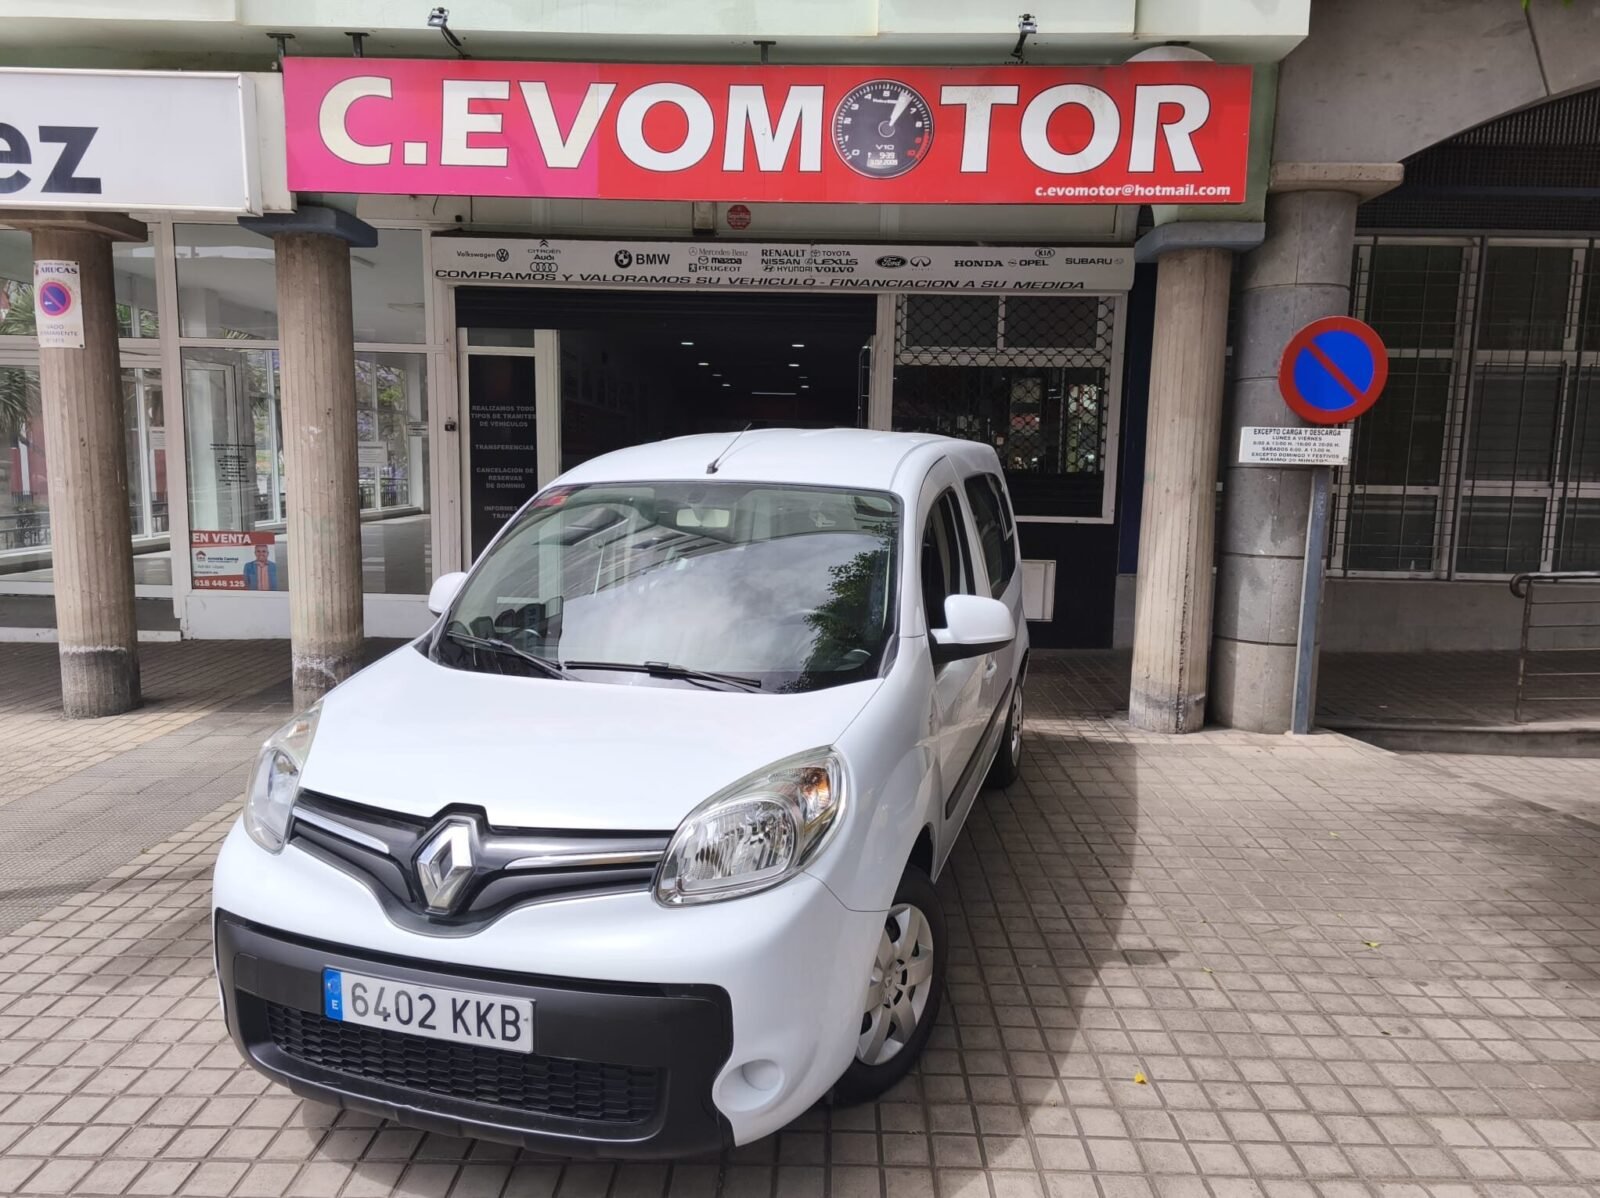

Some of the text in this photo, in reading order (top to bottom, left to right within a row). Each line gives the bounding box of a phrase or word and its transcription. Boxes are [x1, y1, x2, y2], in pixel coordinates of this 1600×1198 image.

[1035, 184, 1230, 196] c.evomotor@hotmail.com
[456, 250, 496, 259] Volkswagen
[761, 249, 807, 257] RENAULT
[636, 254, 670, 265] BMW
[1019, 259, 1049, 267] OPEL
[435, 269, 556, 281] COMPRAMOS
[562, 274, 574, 282] Y
[580, 274, 694, 285] VALORAMOS
[696, 276, 720, 285] SU
[728, 277, 816, 286] VEHICULO
[829, 278, 960, 288] FINANCIACION
[980, 280, 1007, 288] SU
[192, 533, 252, 544] EN VENTA
[332, 1000, 338, 1010] E
[351, 982, 521, 1042] 6402 KKB
